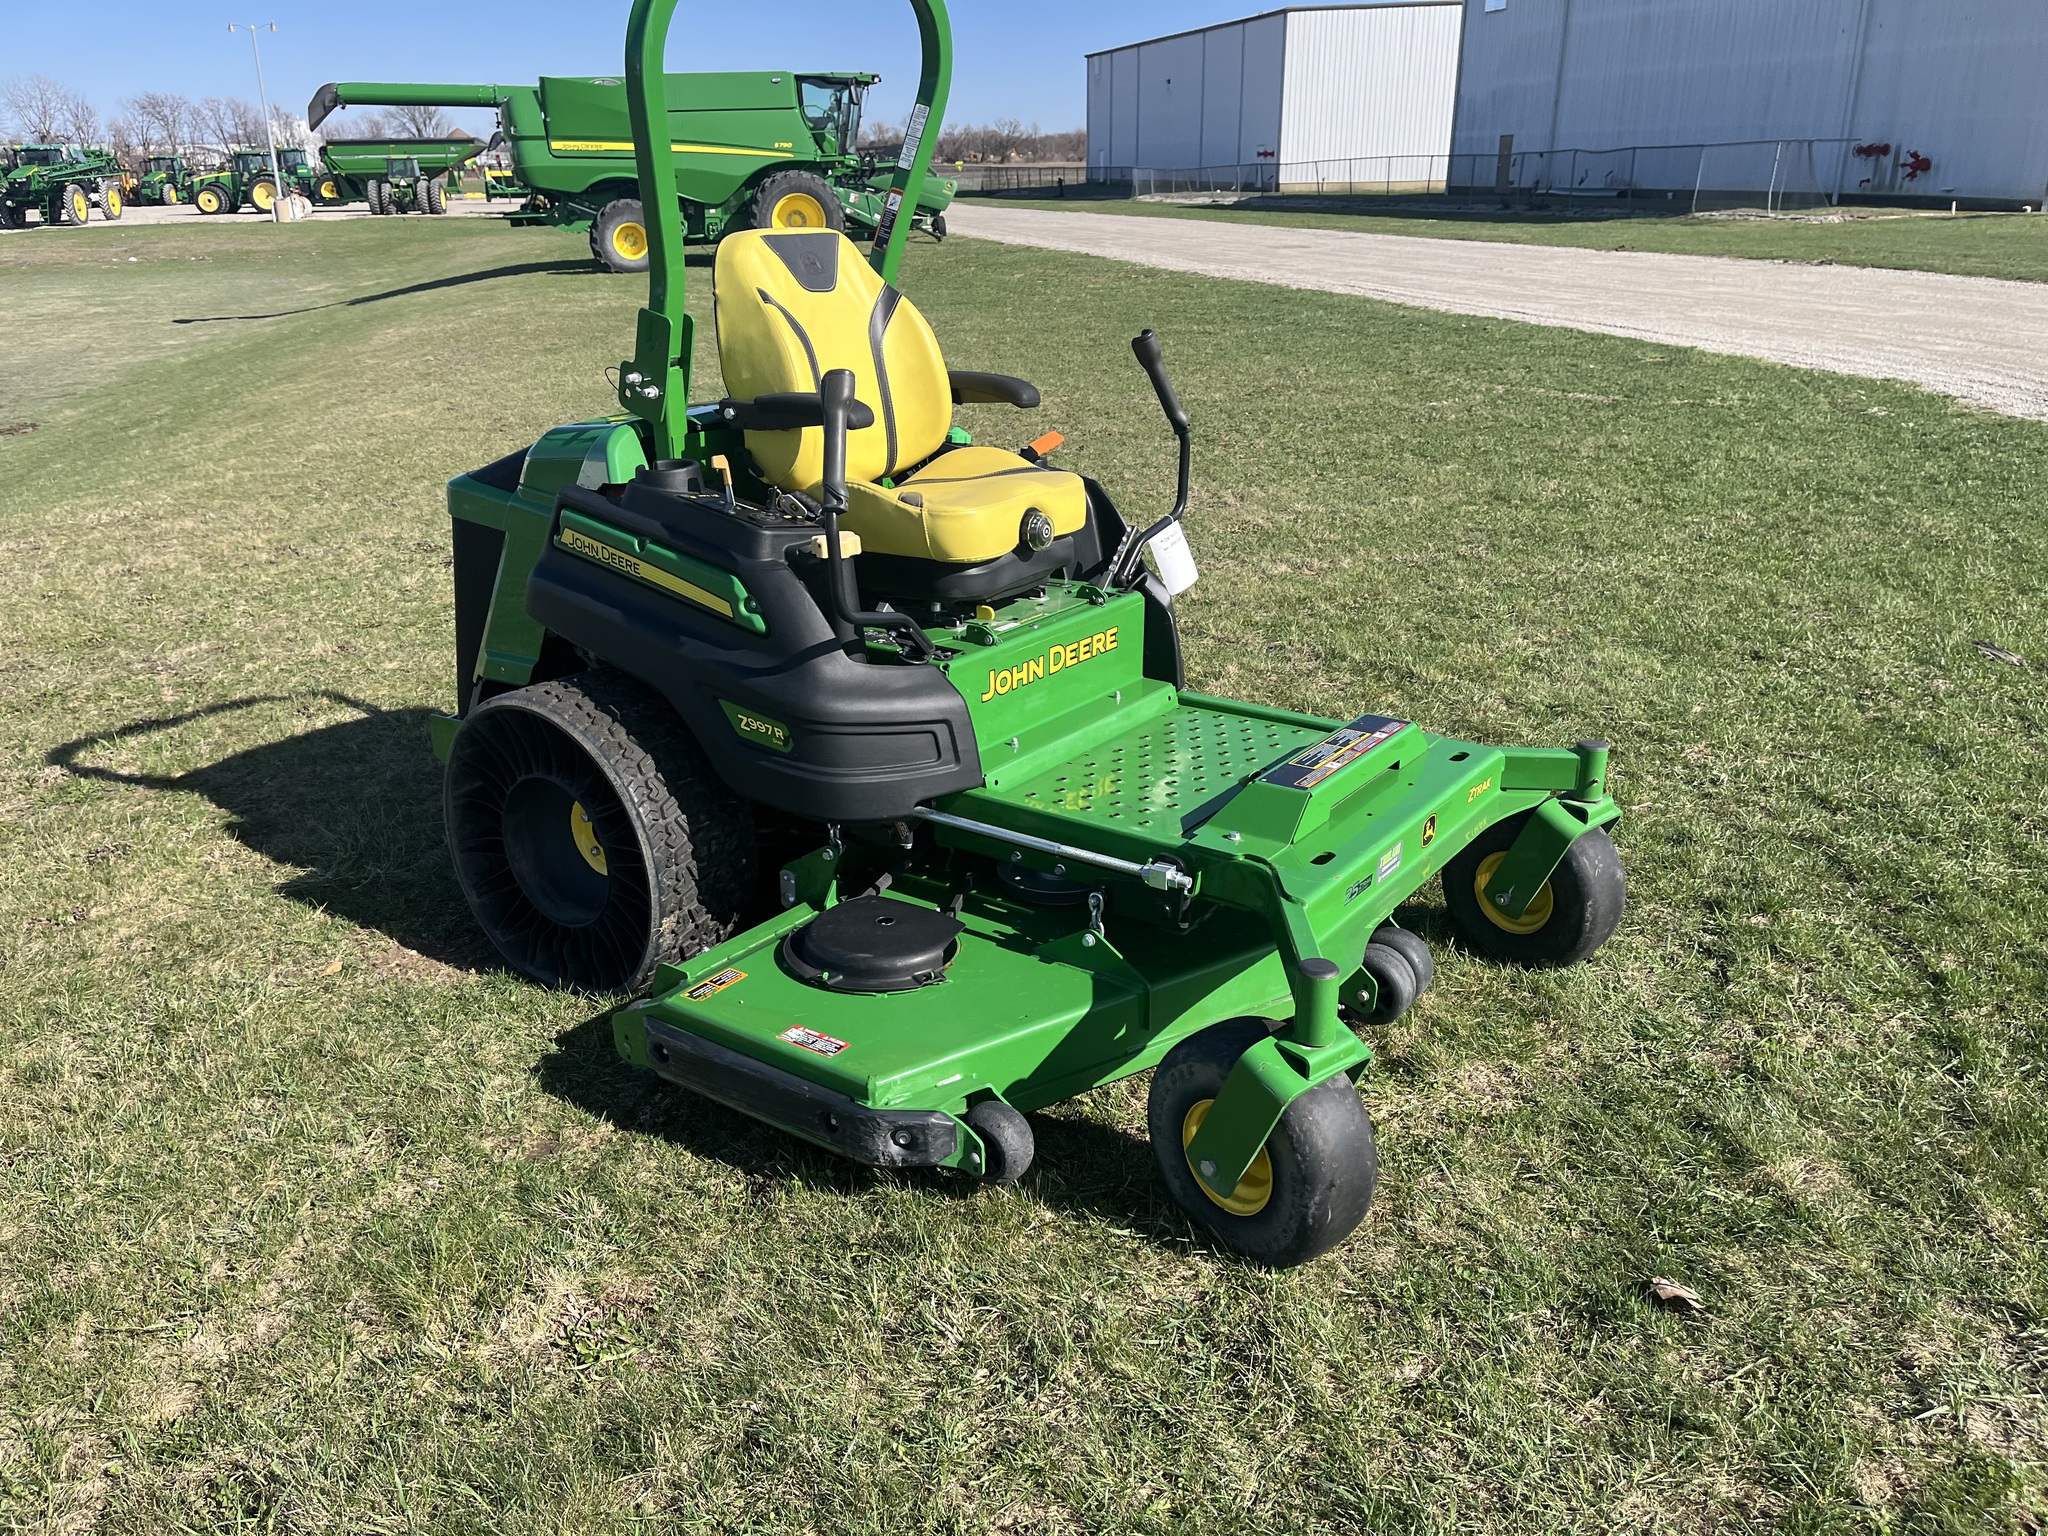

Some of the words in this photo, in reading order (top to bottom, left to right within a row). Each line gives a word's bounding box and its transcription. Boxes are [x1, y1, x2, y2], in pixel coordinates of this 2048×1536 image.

[568, 533, 599, 558] JOHN
[601, 545, 641, 576] DEERE
[981, 654, 1045, 704] JOHN
[1049, 625, 1119, 676] DEERE
[1467, 776, 1493, 804] ZTRAK
